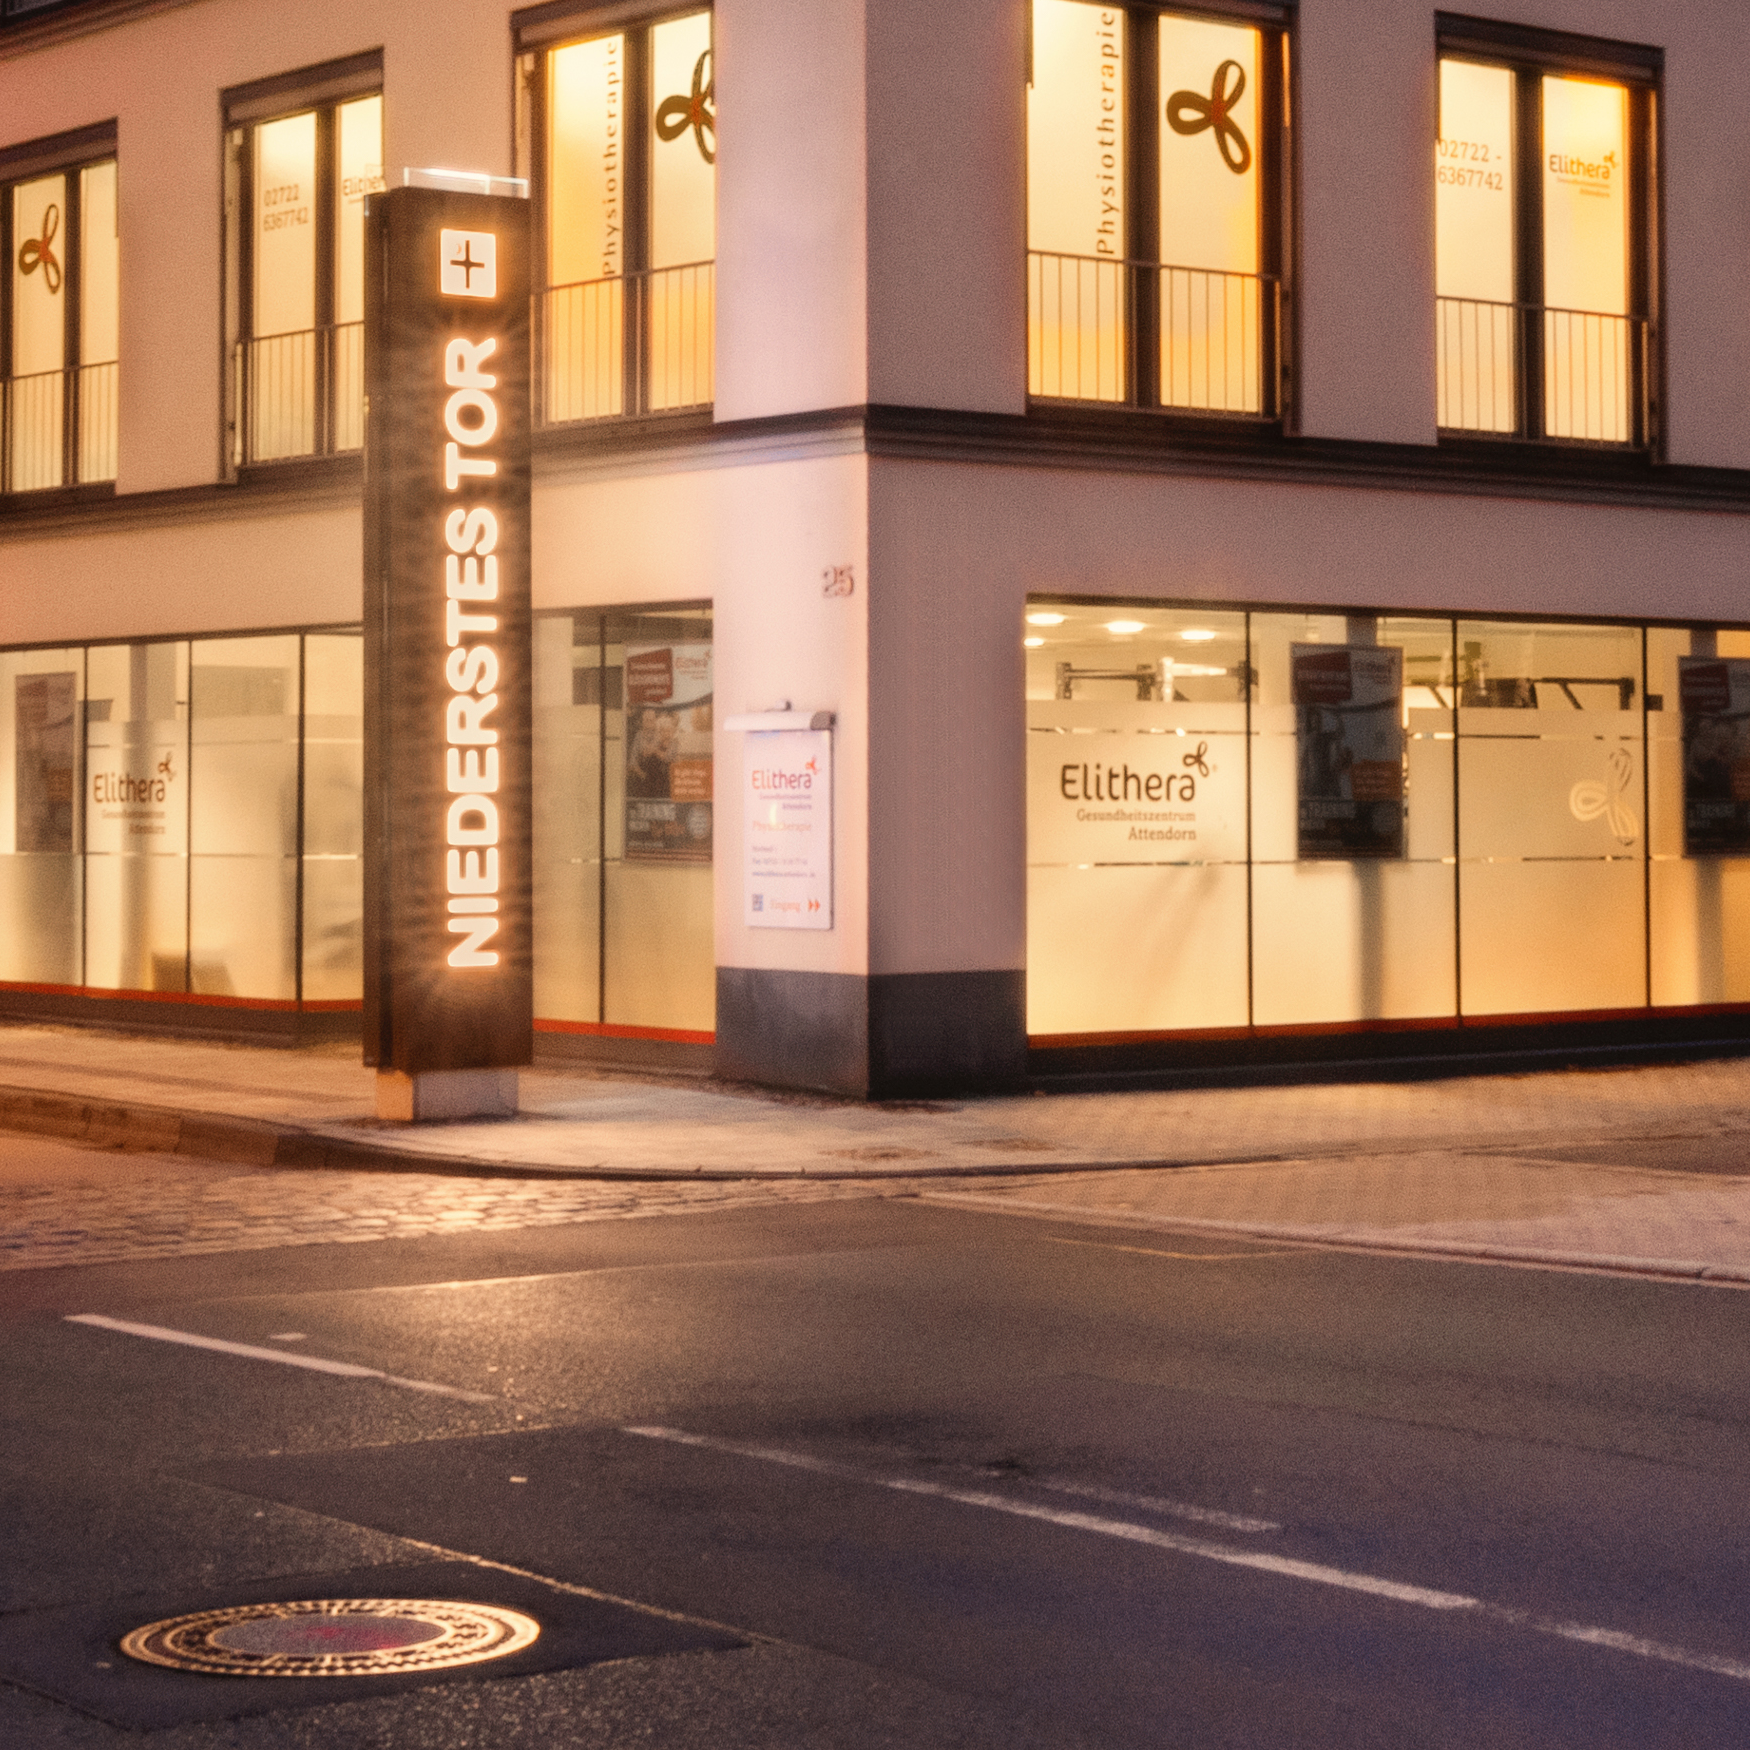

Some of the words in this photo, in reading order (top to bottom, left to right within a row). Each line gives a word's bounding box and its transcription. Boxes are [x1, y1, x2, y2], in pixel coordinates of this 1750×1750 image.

[1096, 10, 1119, 255] Physiotherapie
[603, 40, 621, 276] Physiotherapie
[1438, 139, 1490, 163] 02722
[1437, 165, 1504, 191] 6367742
[1549, 153, 1611, 181] Elithera
[263, 183, 299, 207] 02722
[444, 336, 498, 490] TOR
[822, 564, 855, 598] 25
[445, 507, 500, 968] NIEDERSTES
[93, 771, 166, 803] Elithera
[751, 769, 812, 790] Elithera
[1061, 762, 1196, 803] Elithera
[1076, 808, 1196, 822] Gesundheitszentrum
[1127, 826, 1198, 841] Attendorn
